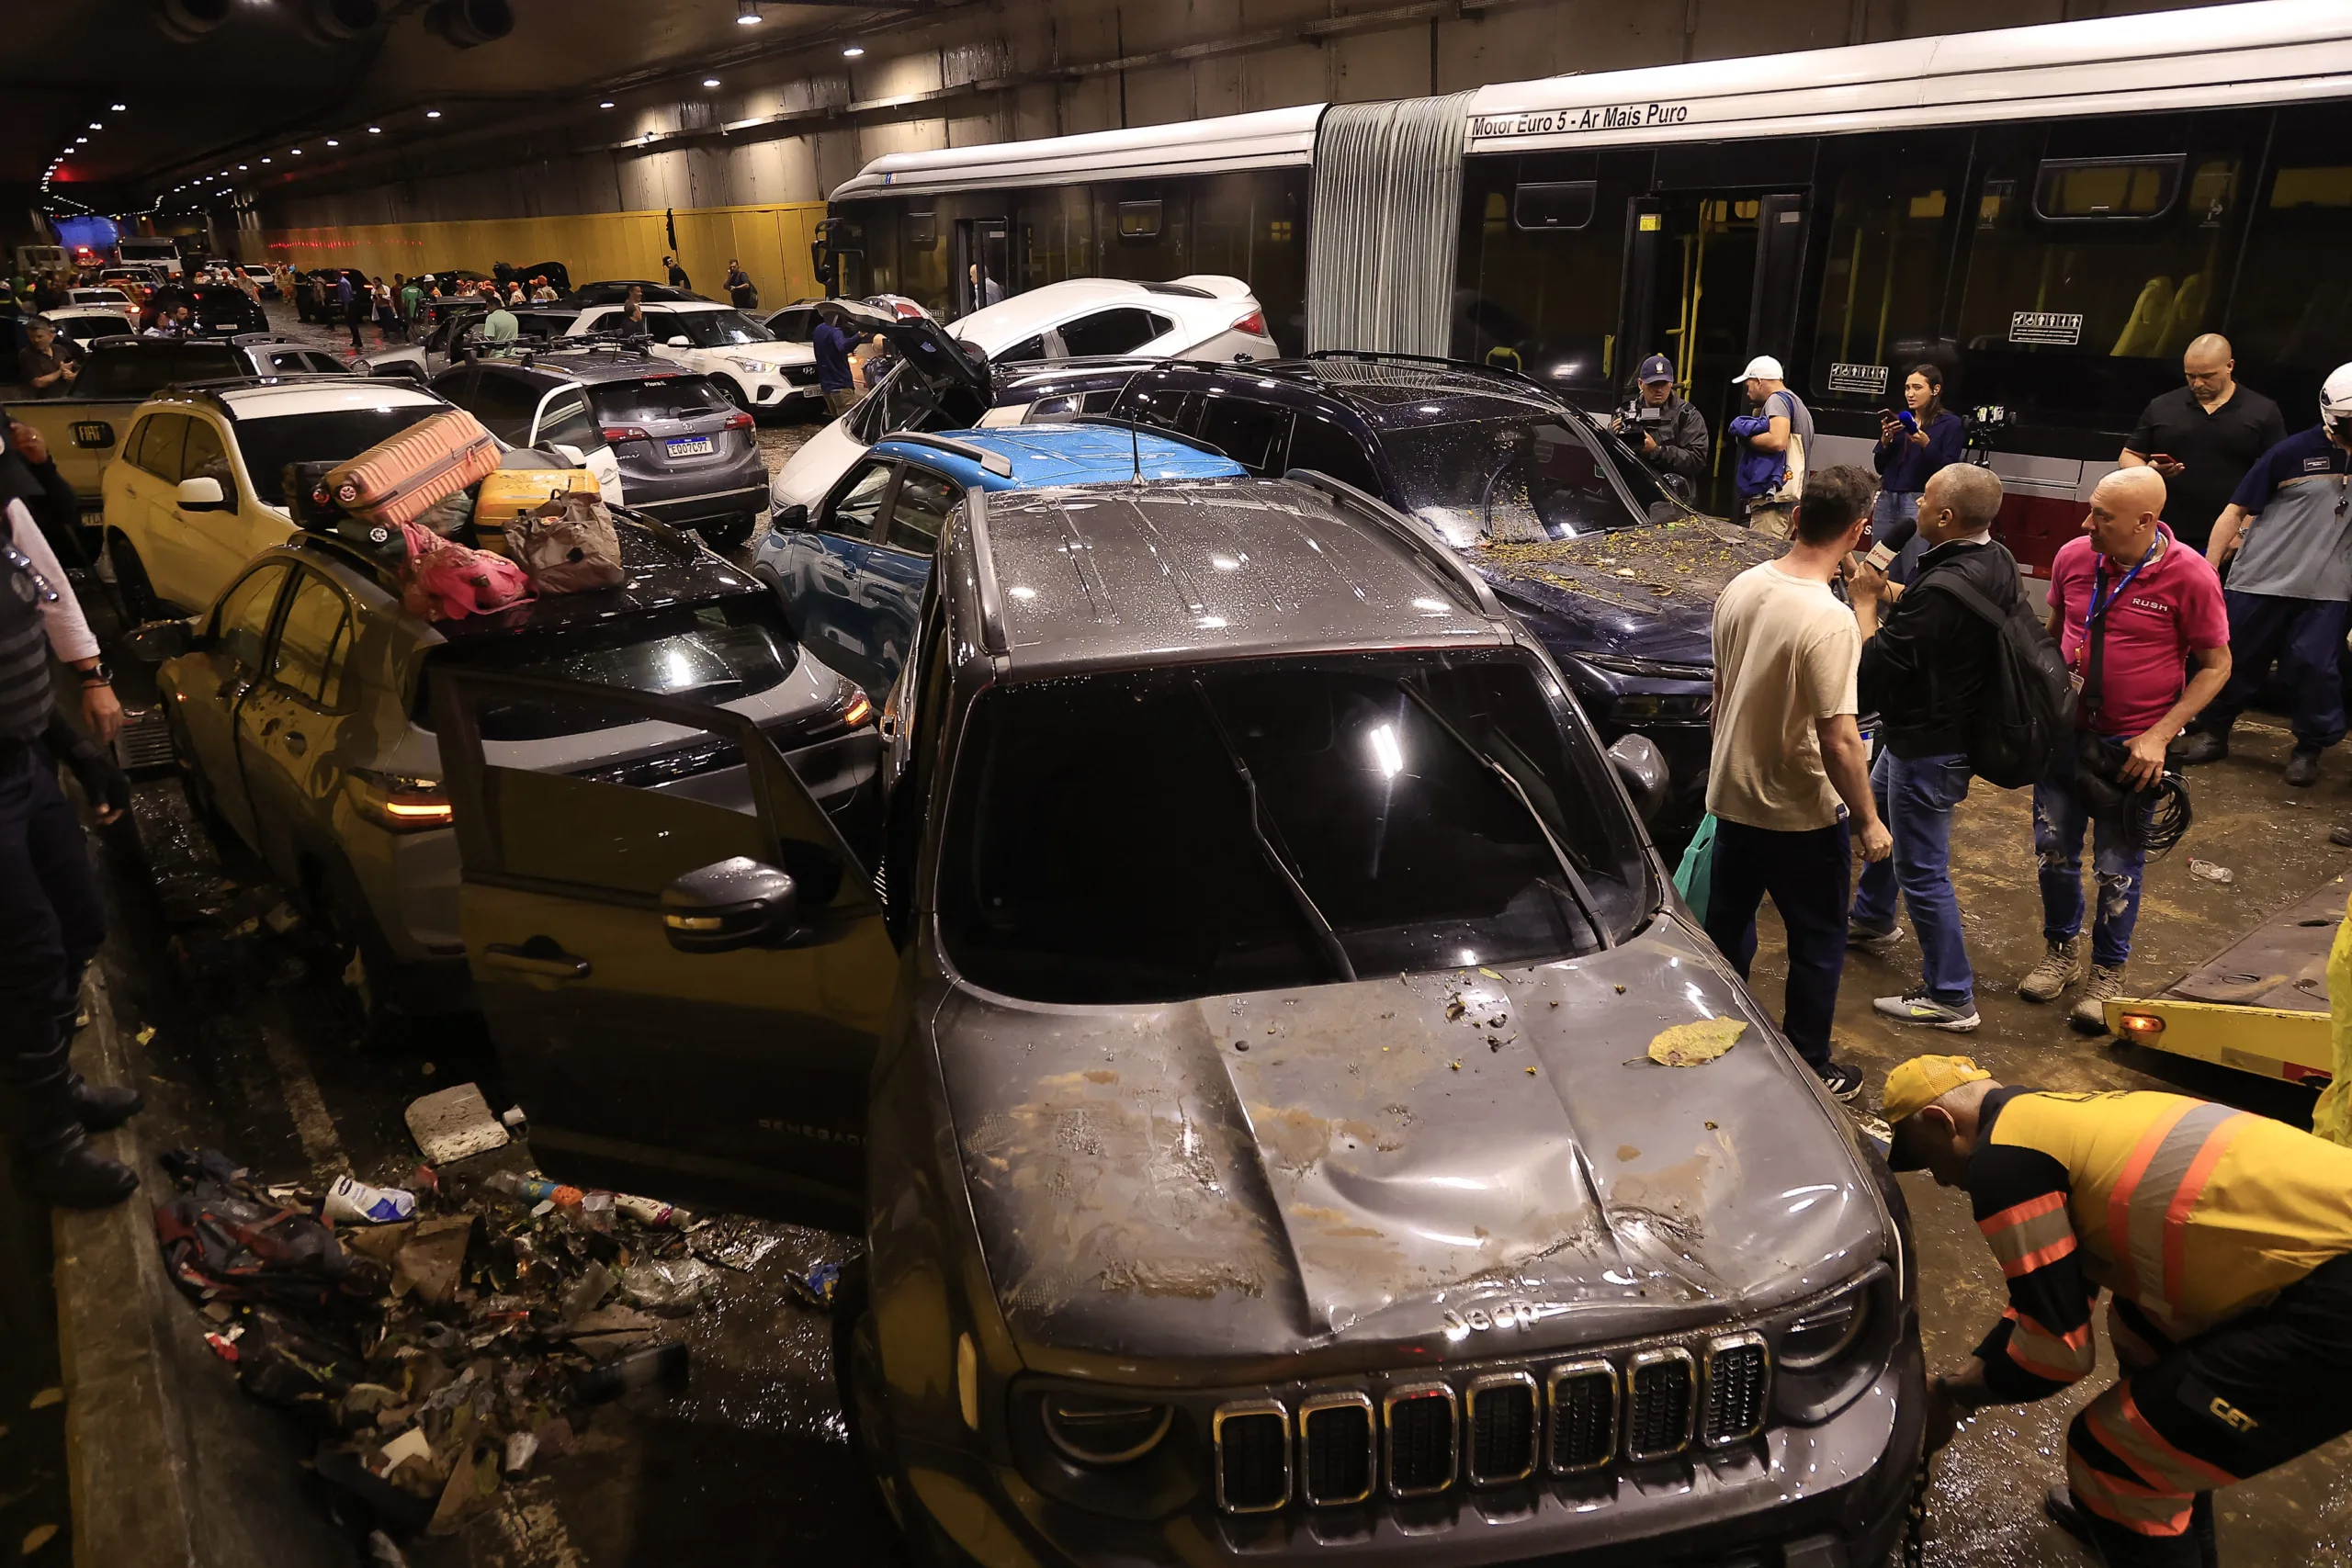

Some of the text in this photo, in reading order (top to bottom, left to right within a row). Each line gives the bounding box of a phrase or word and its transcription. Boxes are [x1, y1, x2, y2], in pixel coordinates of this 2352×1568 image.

[1472, 118, 1513, 136] Motor
[1517, 114, 1553, 133] Euro
[1556, 111, 1567, 131] 5
[1579, 108, 1600, 130] Ar
[1602, 106, 1641, 128] Mais
[1646, 104, 1688, 124] Puro
[78, 425, 100, 441] FIAT
[2132, 598, 2168, 611] RUSH
[1442, 1297, 1541, 1342] Jeep
[2210, 1397, 2258, 1433] CET
